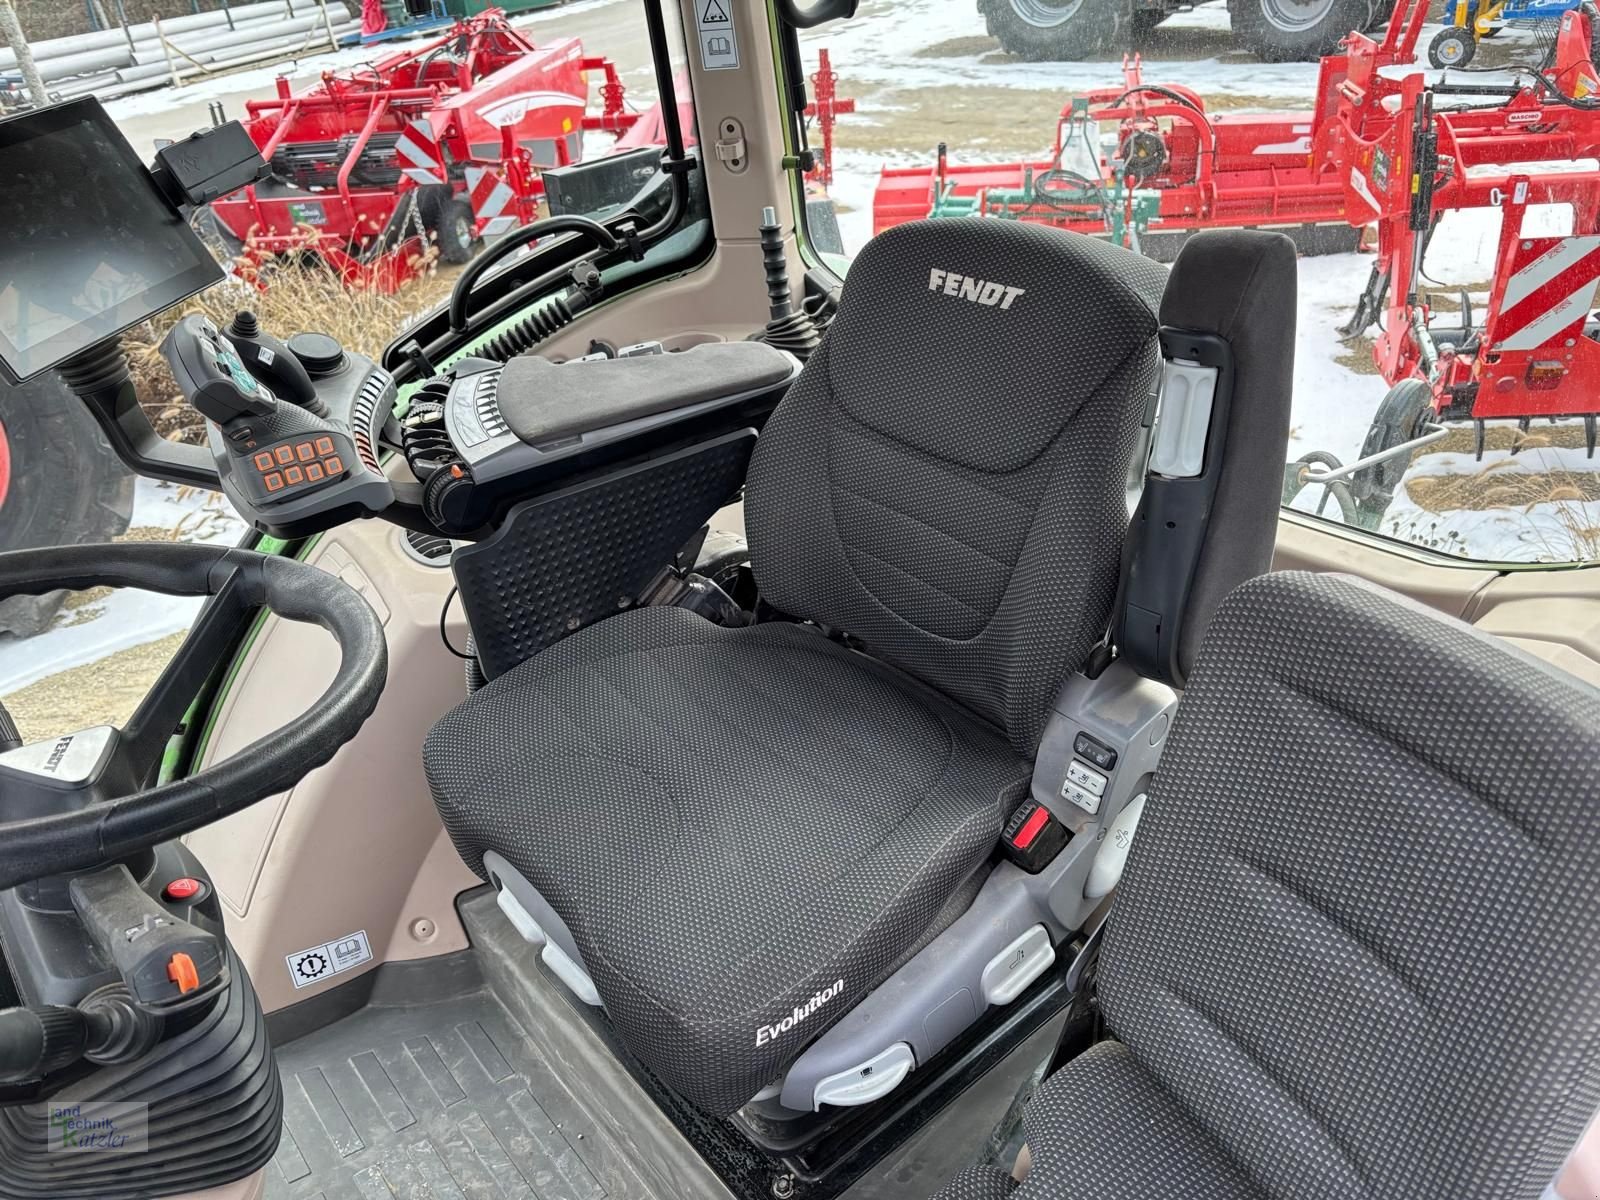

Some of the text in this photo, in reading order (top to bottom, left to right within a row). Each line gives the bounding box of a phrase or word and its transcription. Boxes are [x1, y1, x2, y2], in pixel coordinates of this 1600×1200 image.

[928, 268, 1026, 310] FENDT
[43, 735, 75, 773] FENDT
[756, 978, 844, 1047] Evolution
